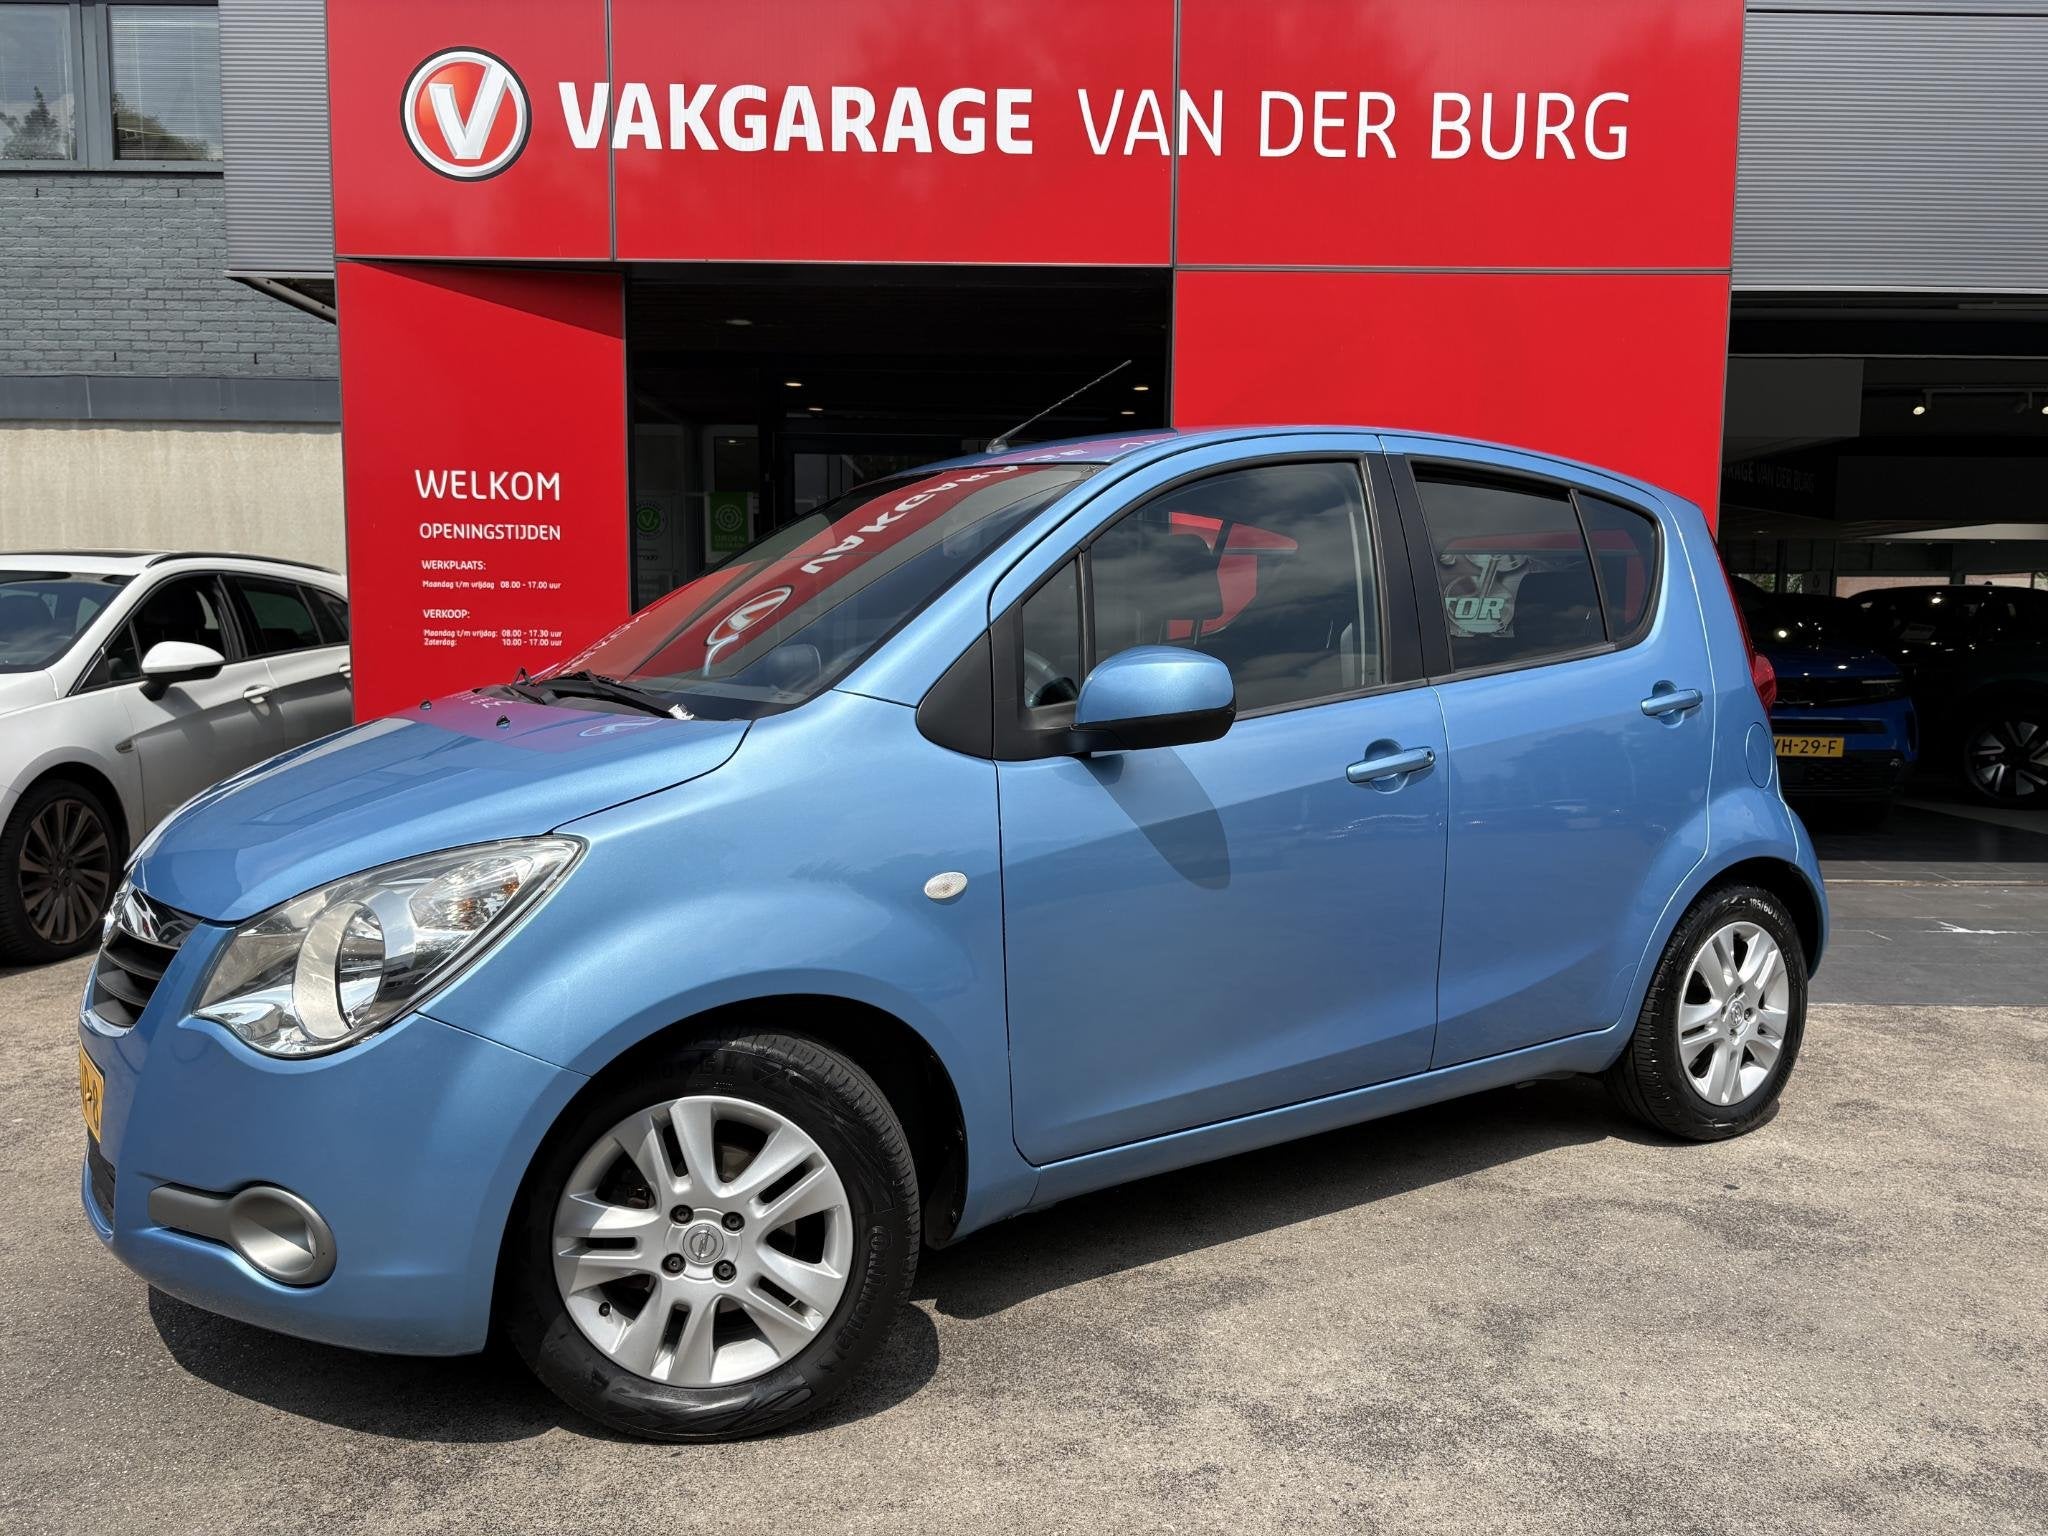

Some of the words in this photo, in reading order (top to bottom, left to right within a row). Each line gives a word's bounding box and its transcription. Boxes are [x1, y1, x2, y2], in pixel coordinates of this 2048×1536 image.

[558, 81, 1033, 155] VAKGARAGE
[1077, 88, 1224, 157] VAN
[1259, 91, 1398, 159] DER
[1431, 92, 1631, 160] BURG
[415, 469, 560, 501] WELKOM
[419, 522, 560, 540] OPENINGSTIJDEN
[421, 560, 486, 570] WERKPLAATS:
[422, 580, 454, 589] Maandag
[456, 580, 470, 588] t/m
[471, 580, 495, 590] vrijdag
[500, 581, 521, 589] 08.00
[422, 609, 470, 619] VERKOOP:
[423, 629, 455, 638] Maandag
[457, 629, 471, 637] t/m
[472, 629, 498, 638] vrijdag:
[501, 629, 521, 638] 08.00
[529, 629, 548, 638] 17.30
[423, 638, 457, 647] Zaterdag:
[529, 639, 548, 647] 17.00
